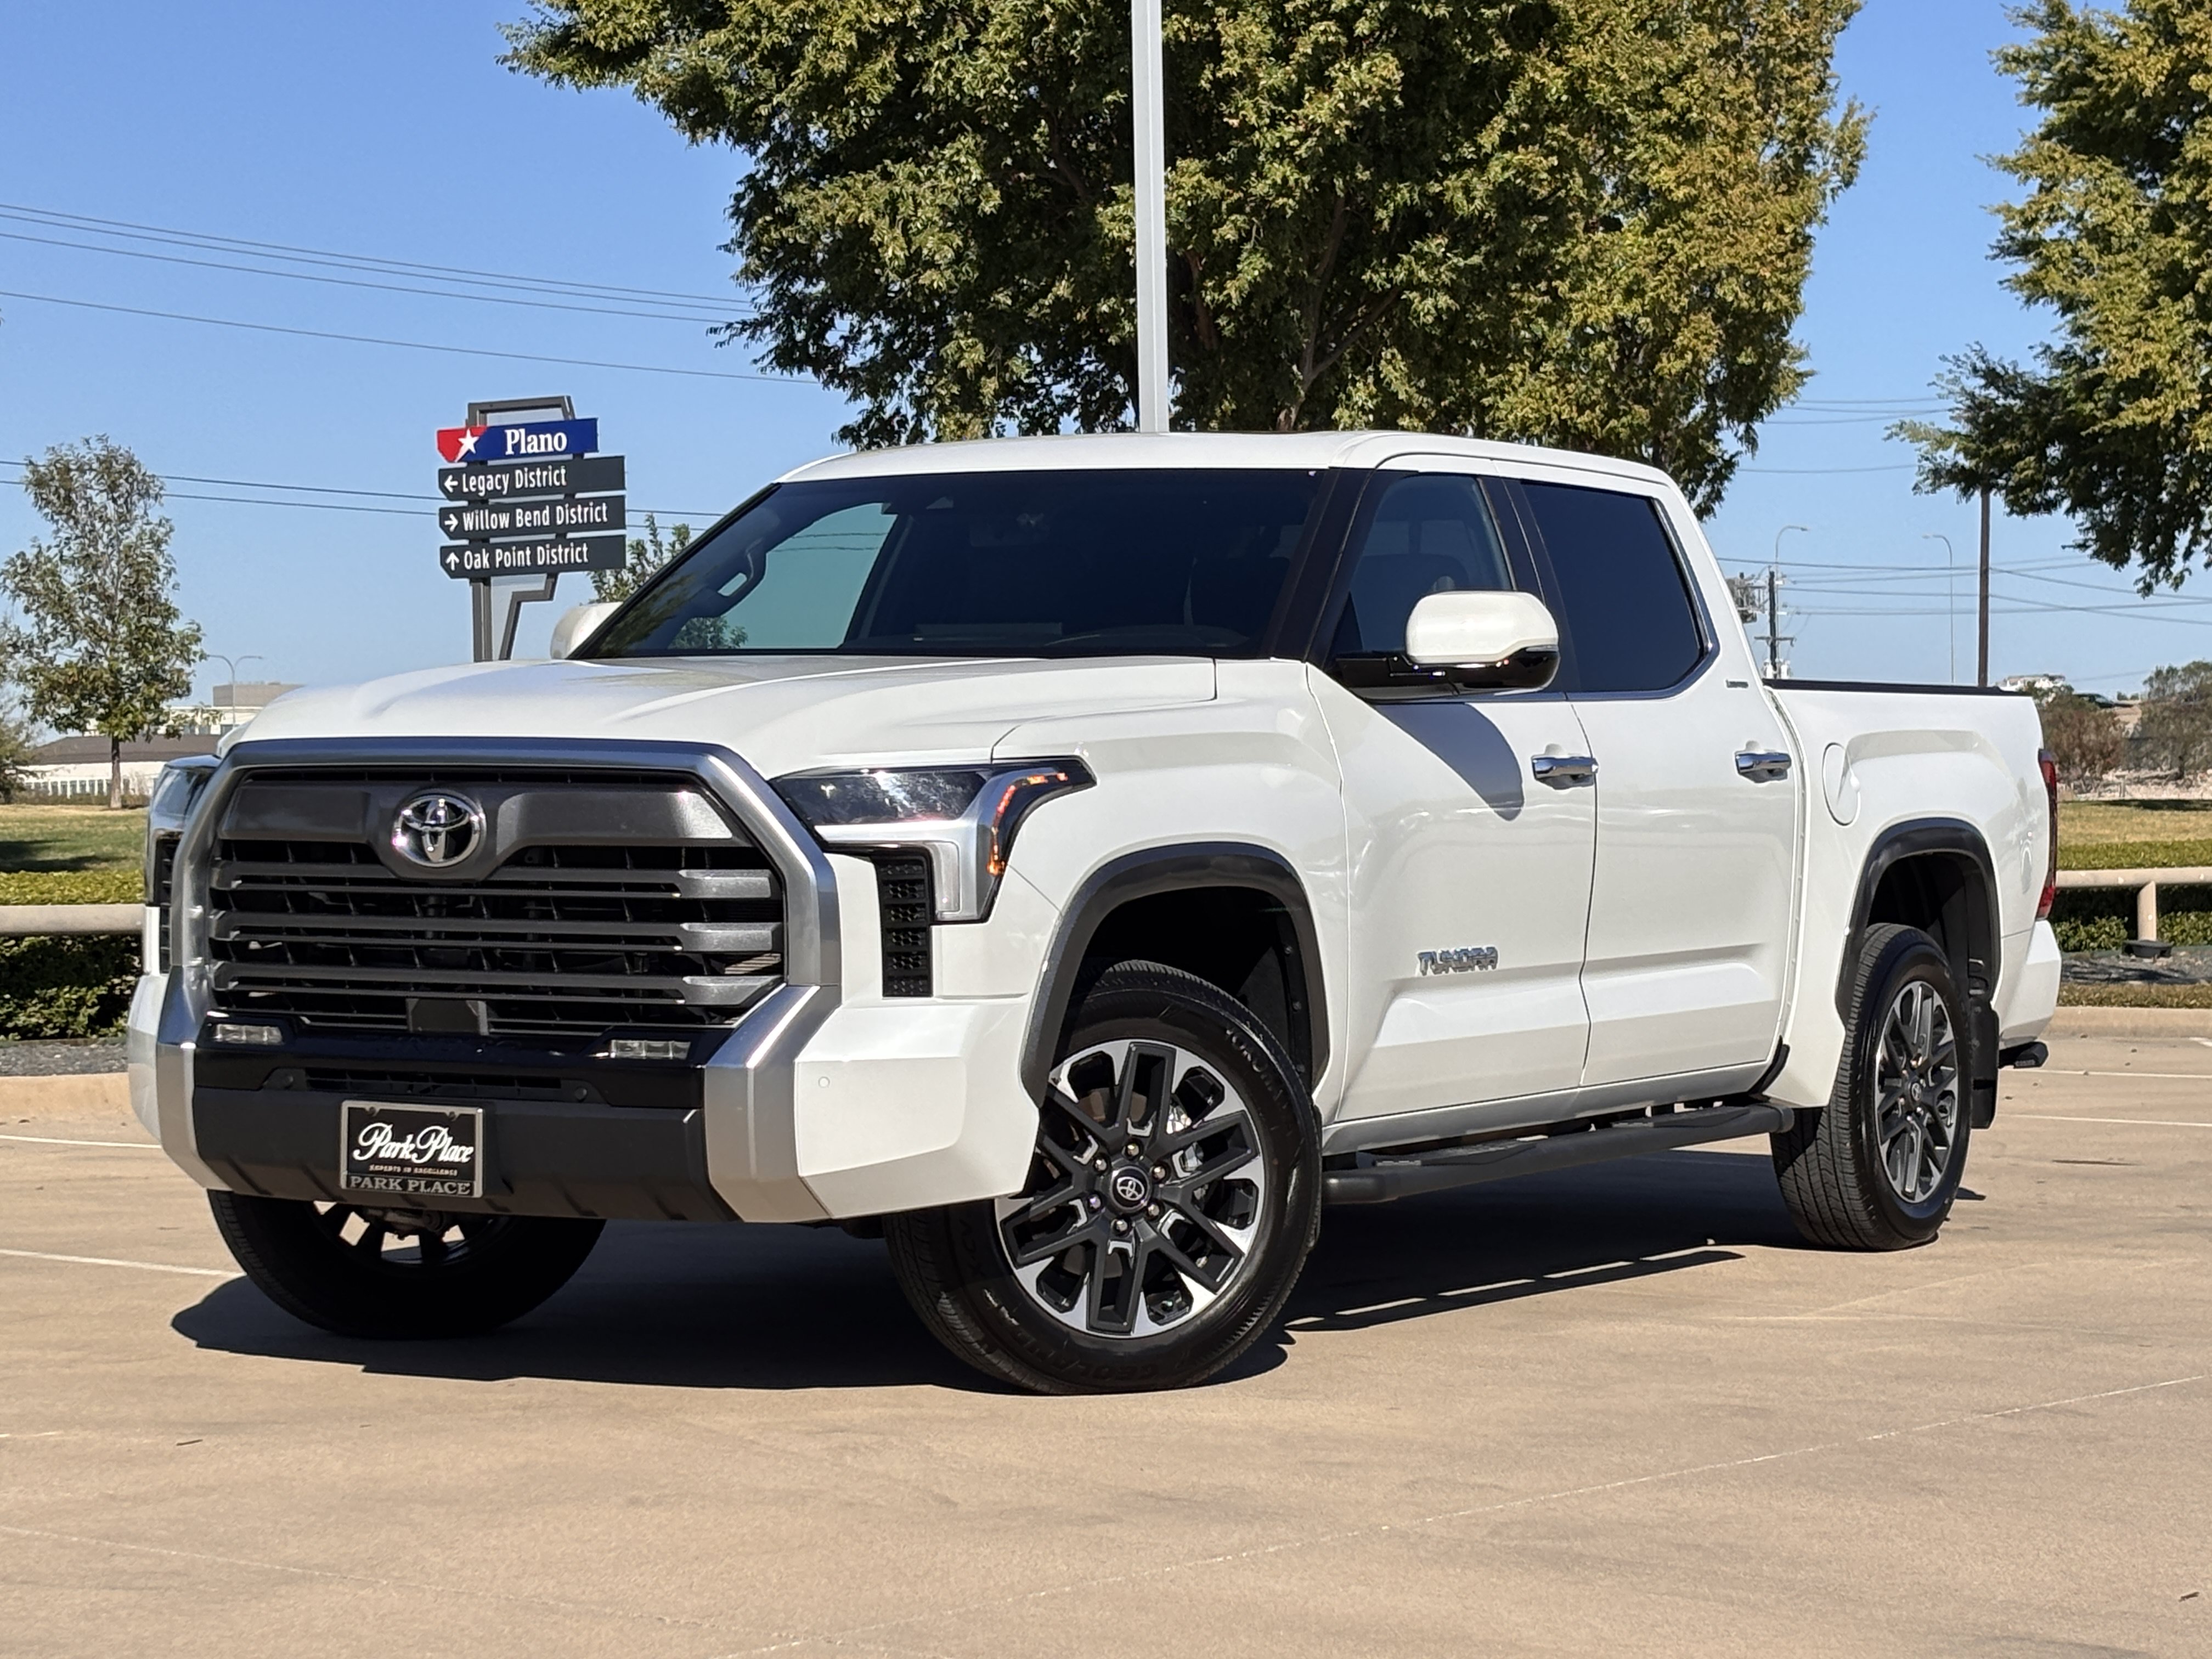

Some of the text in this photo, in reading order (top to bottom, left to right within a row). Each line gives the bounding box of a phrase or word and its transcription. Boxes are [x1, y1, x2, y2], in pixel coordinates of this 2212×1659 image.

[504, 428, 568, 455] Plano
[462, 466, 567, 495] Legacy District
[462, 501, 608, 532] Willow Bend District
[464, 542, 589, 570] Oak Point District
[1417, 946, 1498, 977] TUNDRA
[353, 1122, 474, 1164] Park Place
[349, 1176, 471, 1195] PARK PLACE
